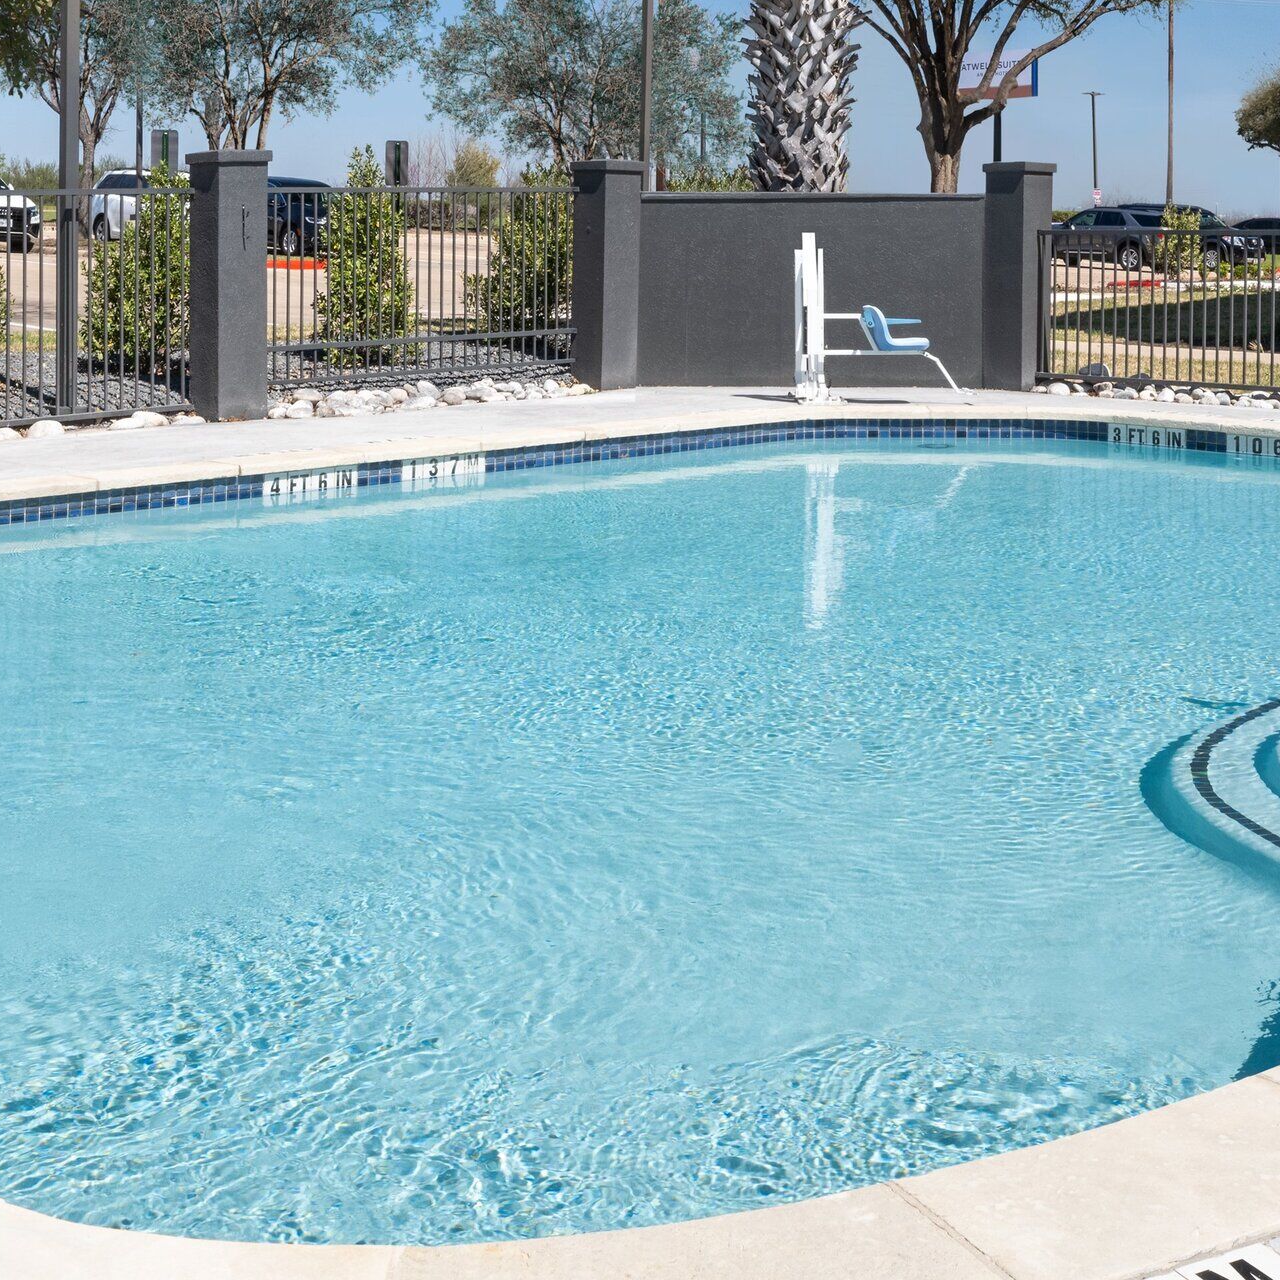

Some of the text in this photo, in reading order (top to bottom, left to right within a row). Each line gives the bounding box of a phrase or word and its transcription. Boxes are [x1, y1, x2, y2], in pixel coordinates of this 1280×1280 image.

[962, 62, 989, 71] ATWEL
[1113, 427, 1121, 442] 3
[1152, 430, 1161, 446] 6
[467, 454, 479, 472] M
[270, 477, 280, 493] 4
[319, 472, 328, 489] 6
